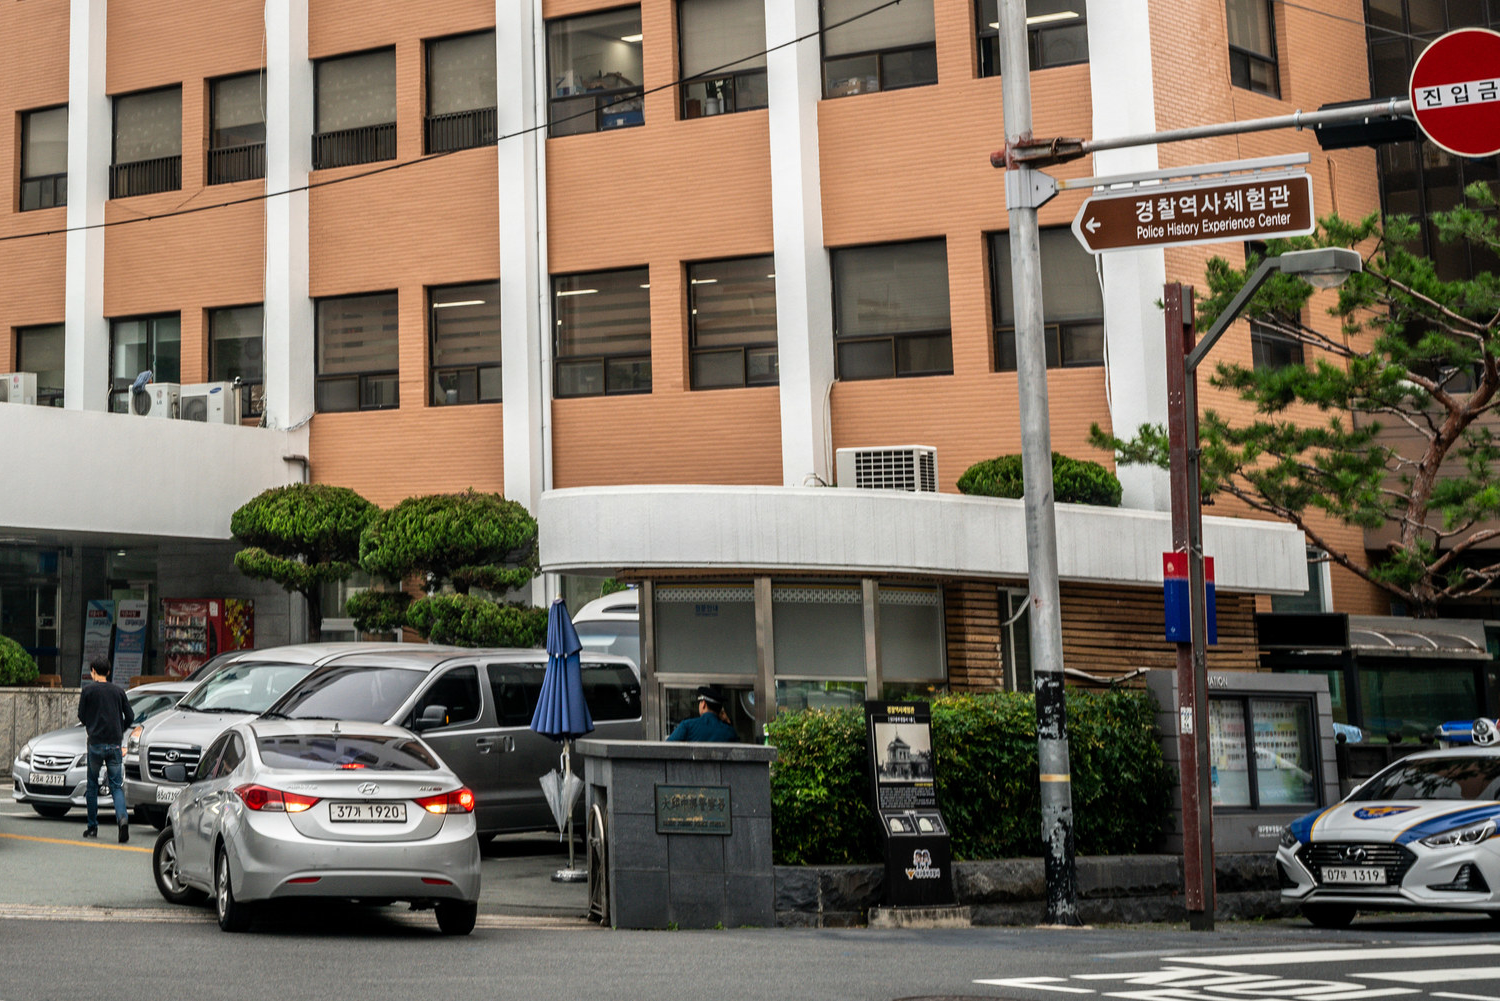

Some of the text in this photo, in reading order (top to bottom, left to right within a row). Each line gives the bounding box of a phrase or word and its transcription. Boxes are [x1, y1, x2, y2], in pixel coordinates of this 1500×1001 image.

[1423, 81, 1498, 107] 진입금
[1136, 185, 1290, 223] 경찰역사체험관
[1137, 212, 1291, 240] Police History Experience Center
[368, 805, 399, 818] 1920
[1353, 870, 1379, 881] 1319
